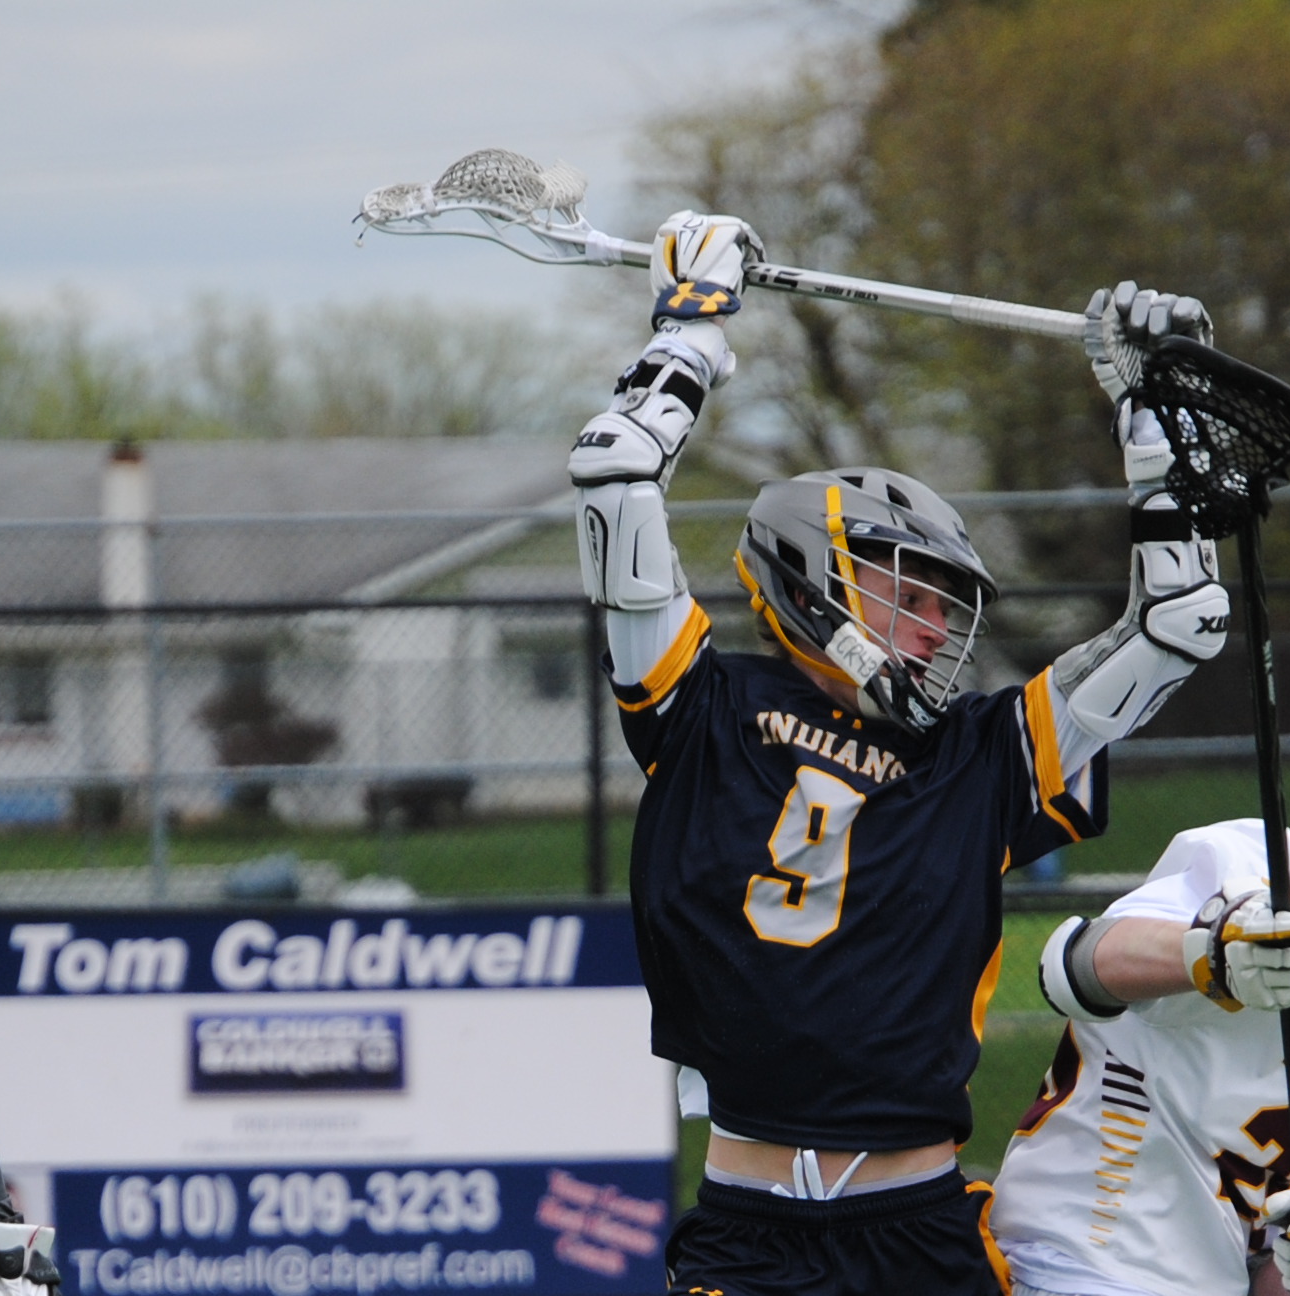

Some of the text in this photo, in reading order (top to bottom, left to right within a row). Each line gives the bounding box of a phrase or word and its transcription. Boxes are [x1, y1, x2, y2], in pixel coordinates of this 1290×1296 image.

[757, 710, 908, 784] INDIANS
[743, 765, 867, 948] 9
[8, 914, 585, 993] Tom Caldwell
[100, 1174, 238, 1243] (610)
[247, 1169, 502, 1238] 209-3233
